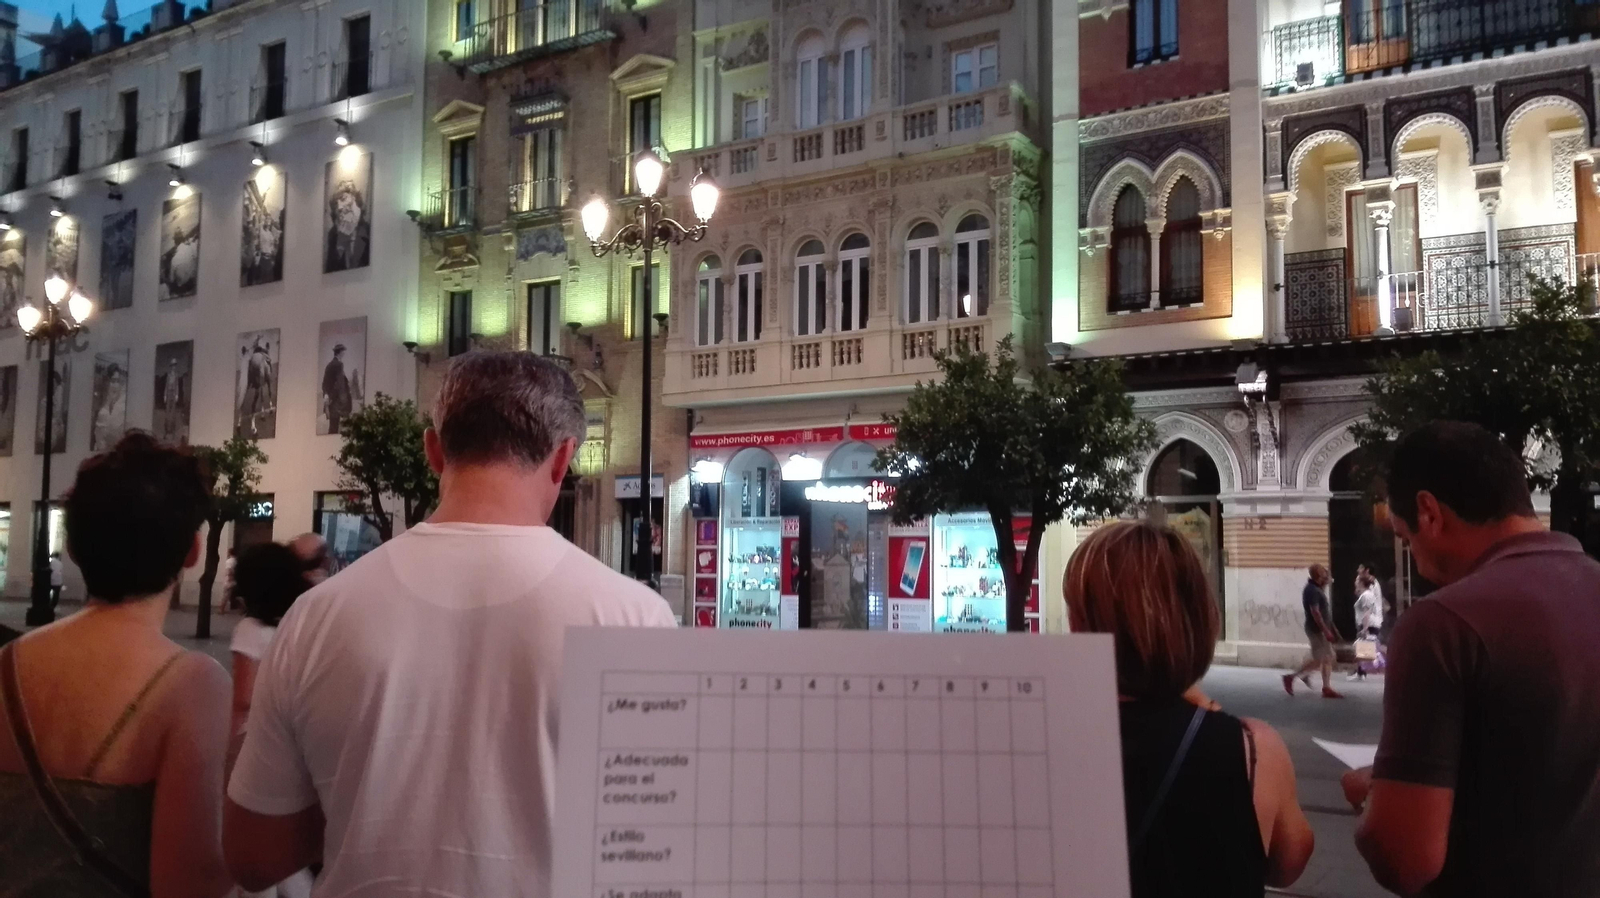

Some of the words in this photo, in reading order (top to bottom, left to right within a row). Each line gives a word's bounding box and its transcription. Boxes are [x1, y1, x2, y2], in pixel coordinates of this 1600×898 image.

[695, 435, 774, 447] www.phonecity.es
[729, 617, 772, 630] phonecity
[706, 677, 712, 690] 1
[739, 677, 747, 690] 2
[774, 678, 782, 691] 3
[808, 678, 816, 690] 4
[842, 679, 850, 692] 5
[876, 679, 884, 692] 6
[911, 679, 919, 692] 7
[946, 680, 954, 693] 8
[981, 680, 988, 693] 9
[1016, 681, 1032, 694] 10
[606, 698, 638, 714] ¿Me
[641, 698, 687, 714] gusta?
[604, 754, 689, 769] ¿Adecuada
[603, 774, 638, 788] para
[641, 772, 655, 785] el
[602, 789, 677, 805] concurso?
[601, 829, 646, 847] ¿Estilo
[601, 847, 672, 863] sevillano?
